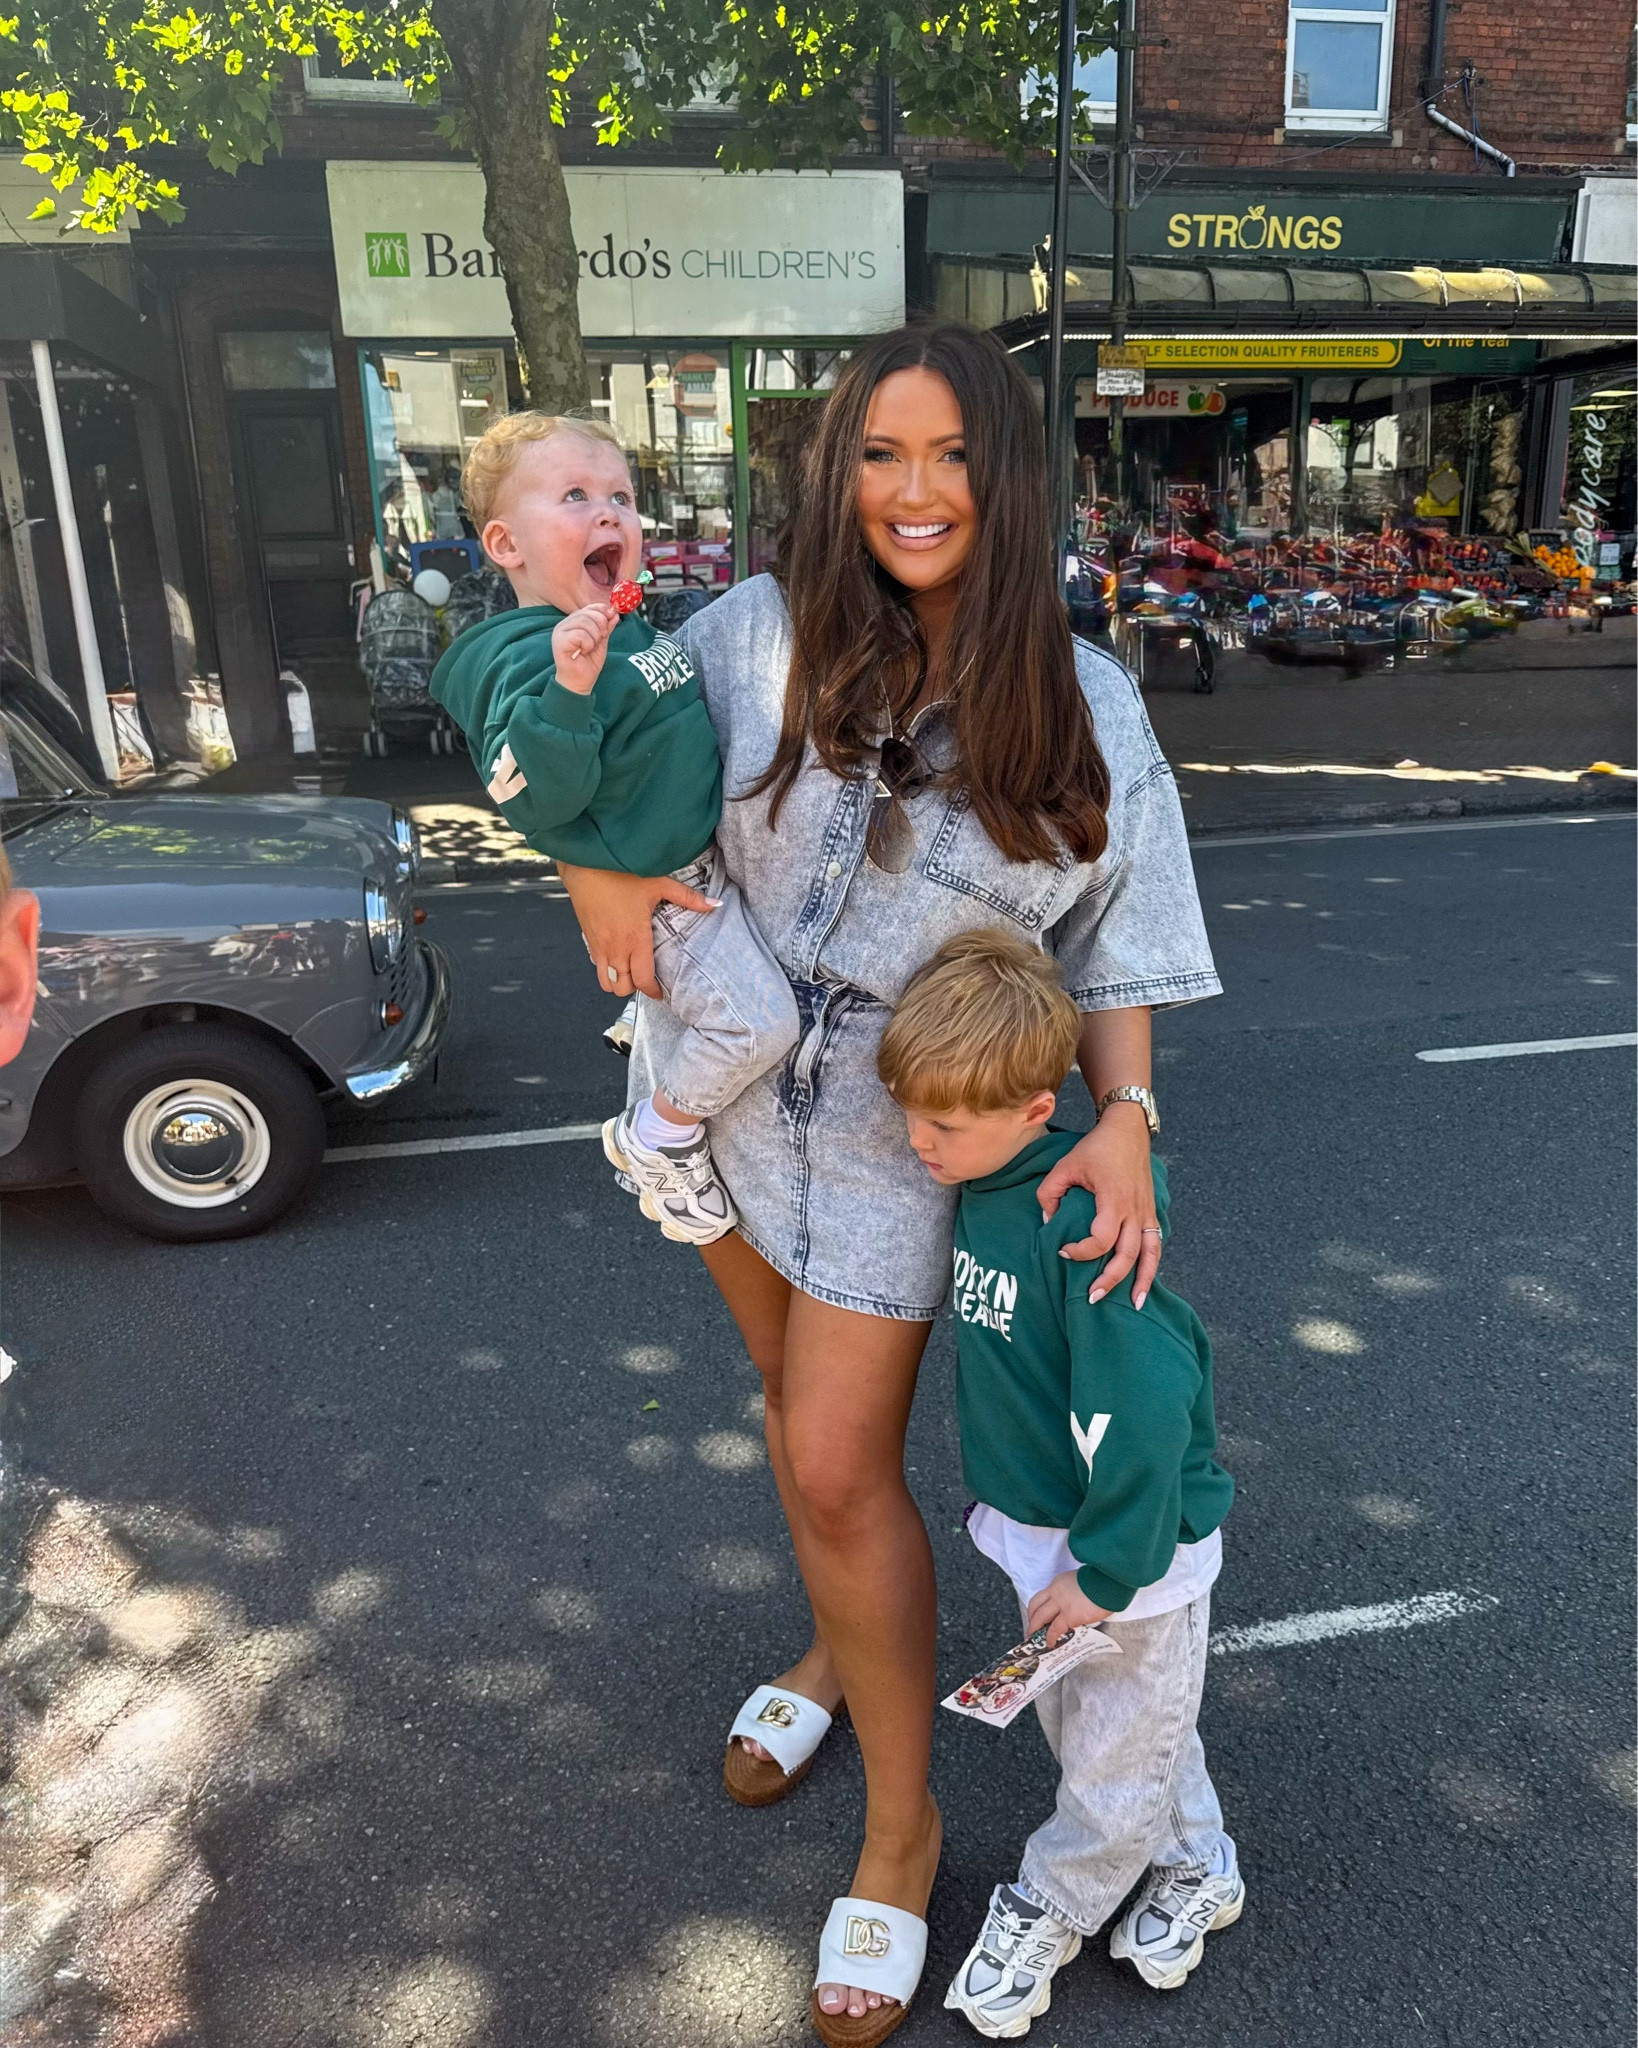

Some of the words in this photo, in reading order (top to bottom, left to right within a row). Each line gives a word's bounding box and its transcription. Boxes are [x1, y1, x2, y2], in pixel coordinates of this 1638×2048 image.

[1167, 206, 1343, 250] STRONGS
[421, 232, 671, 279] Barrdo's
[681, 249, 876, 279] CHILDREN'S
[1166, 345, 1238, 357] SELECTION
[1243, 345, 1297, 357] QUALITY
[1301, 345, 1380, 357] FRUITERERS
